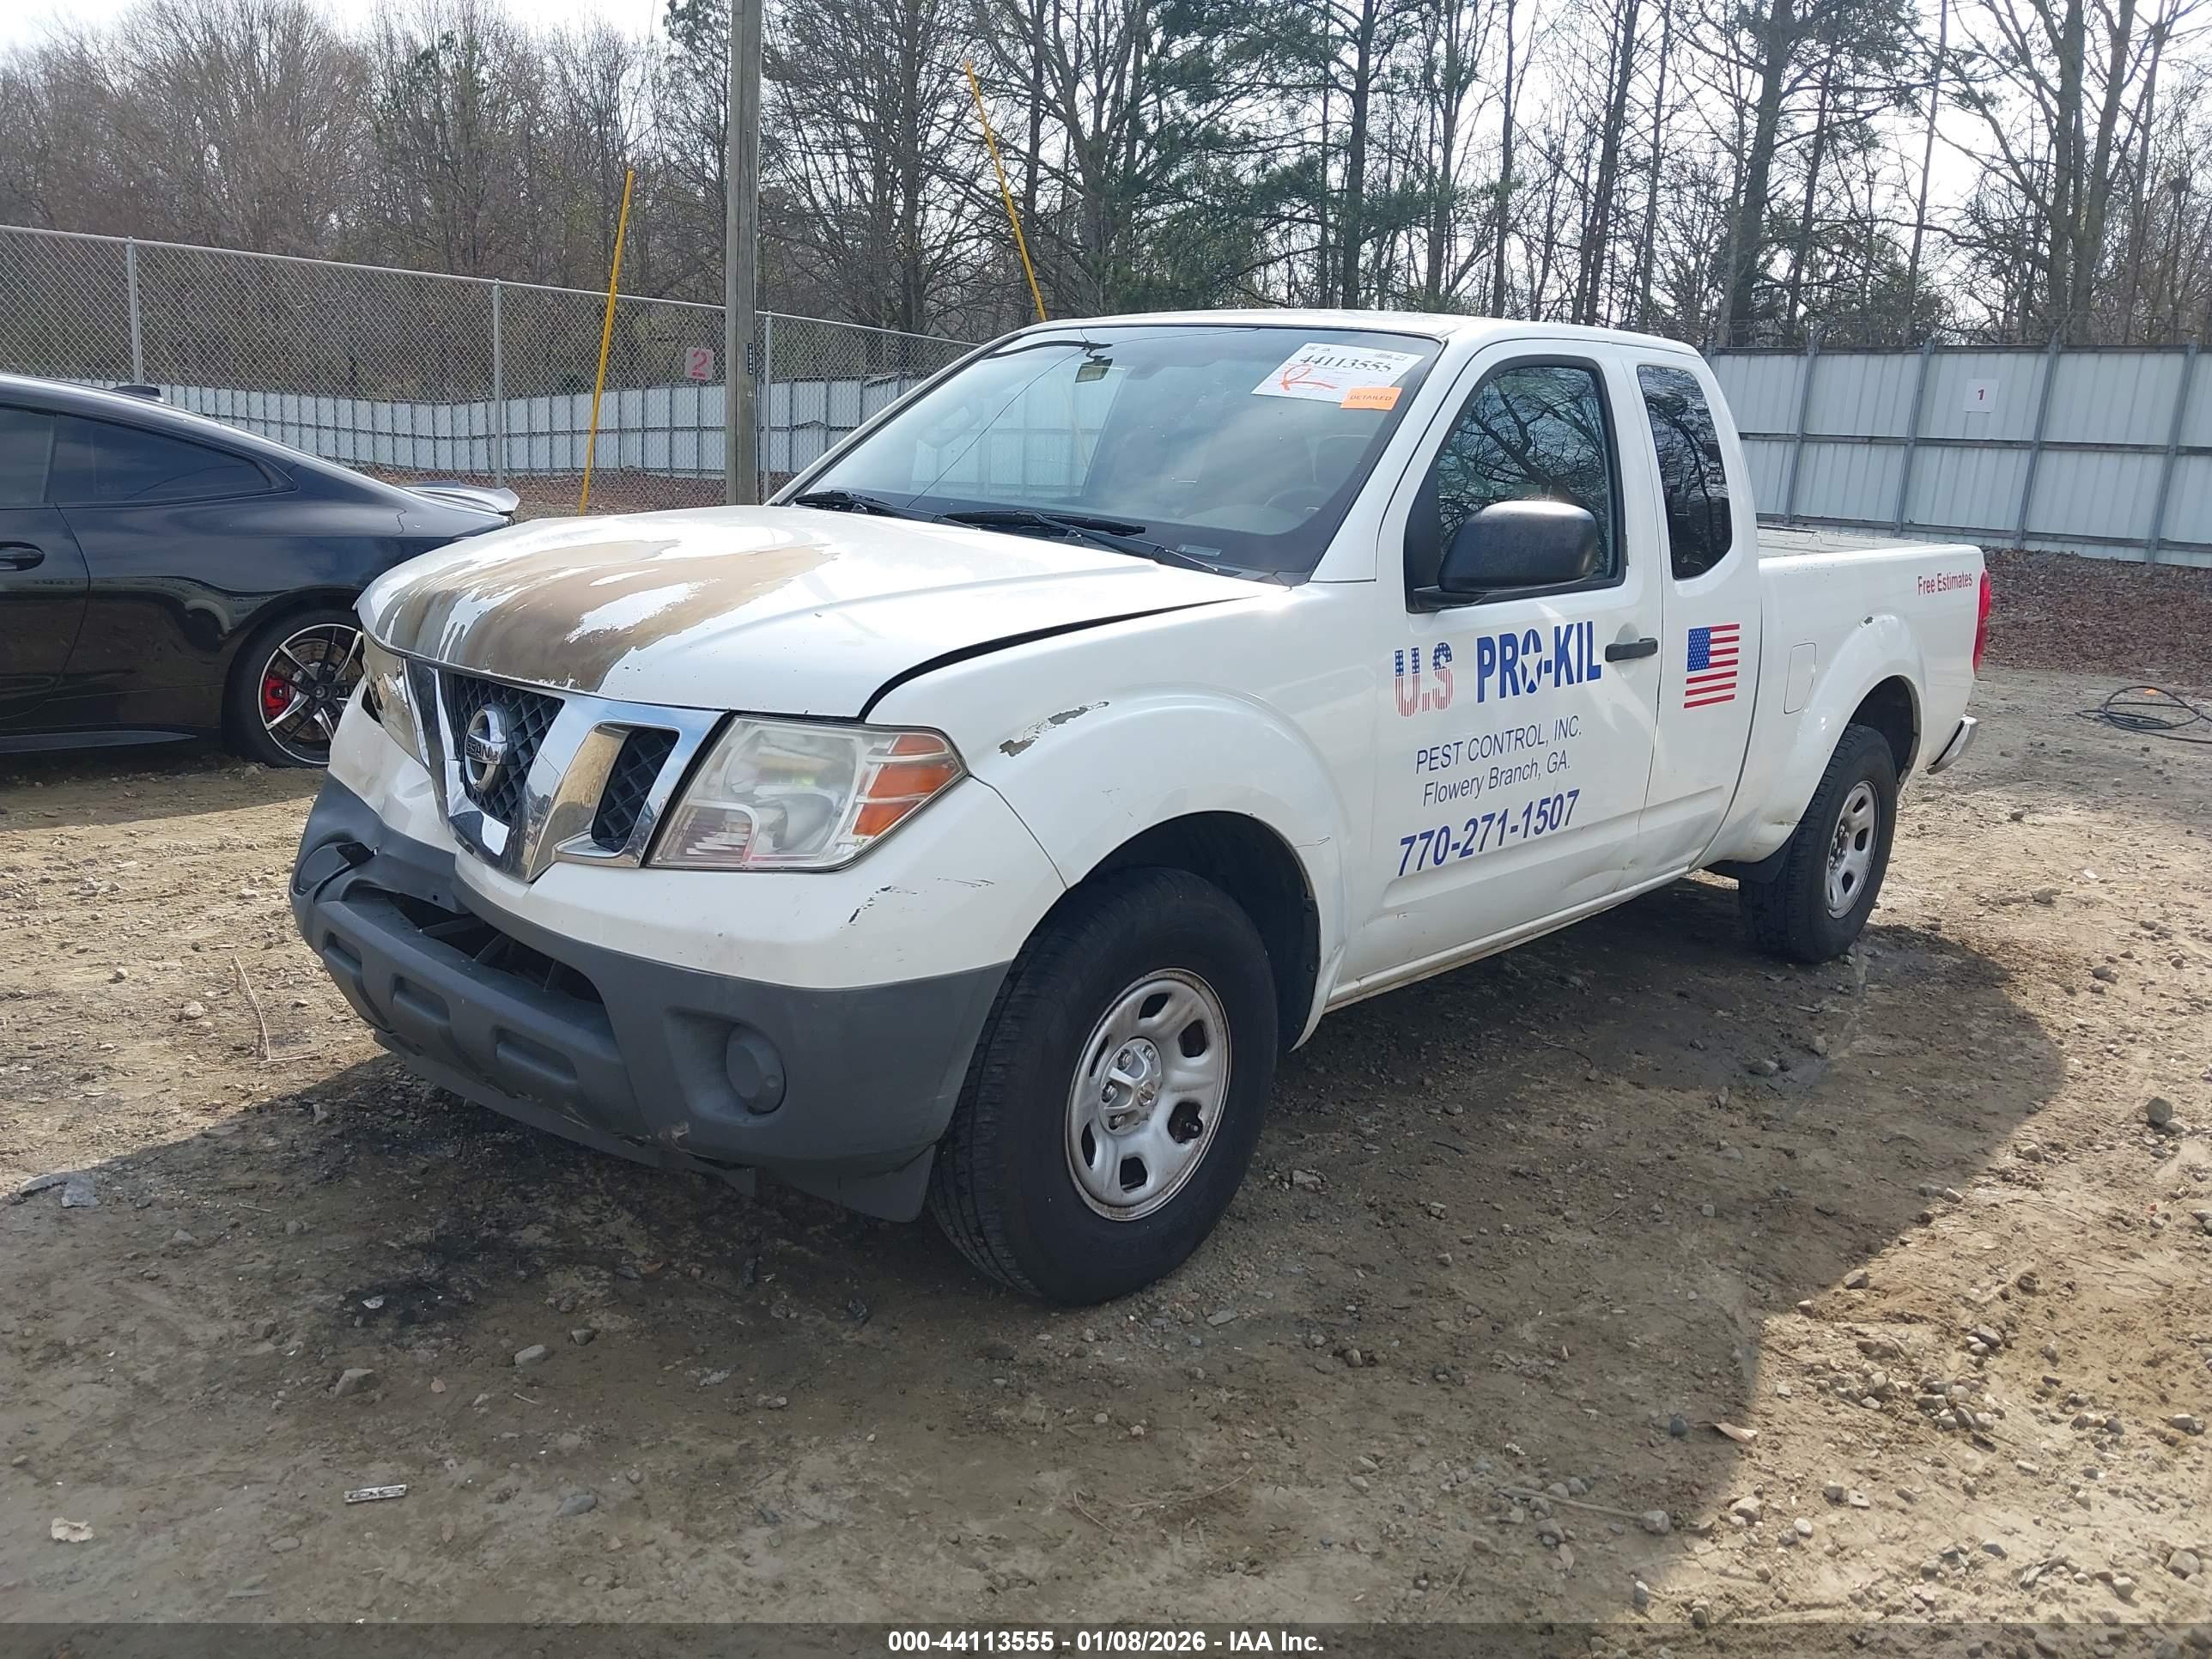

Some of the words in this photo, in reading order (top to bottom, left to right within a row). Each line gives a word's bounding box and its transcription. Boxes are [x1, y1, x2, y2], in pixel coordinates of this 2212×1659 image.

[692, 350, 708, 378] 2
[1299, 354, 1392, 373] 44113555
[1978, 388, 1985, 401] 1
[1917, 575, 1936, 596] Free
[1936, 570, 1973, 592] Estimates
[1476, 621, 1602, 703] PRO-KIL
[1415, 741, 1464, 775] PEST
[1468, 723, 1549, 759] CONTROL,
[1553, 714, 1583, 741] INC.
[1423, 775, 1484, 807] Flowery
[1488, 759, 1542, 791] Branch,
[1547, 750, 1571, 775] GA.
[1397, 788, 1581, 878] 770-271-1507
